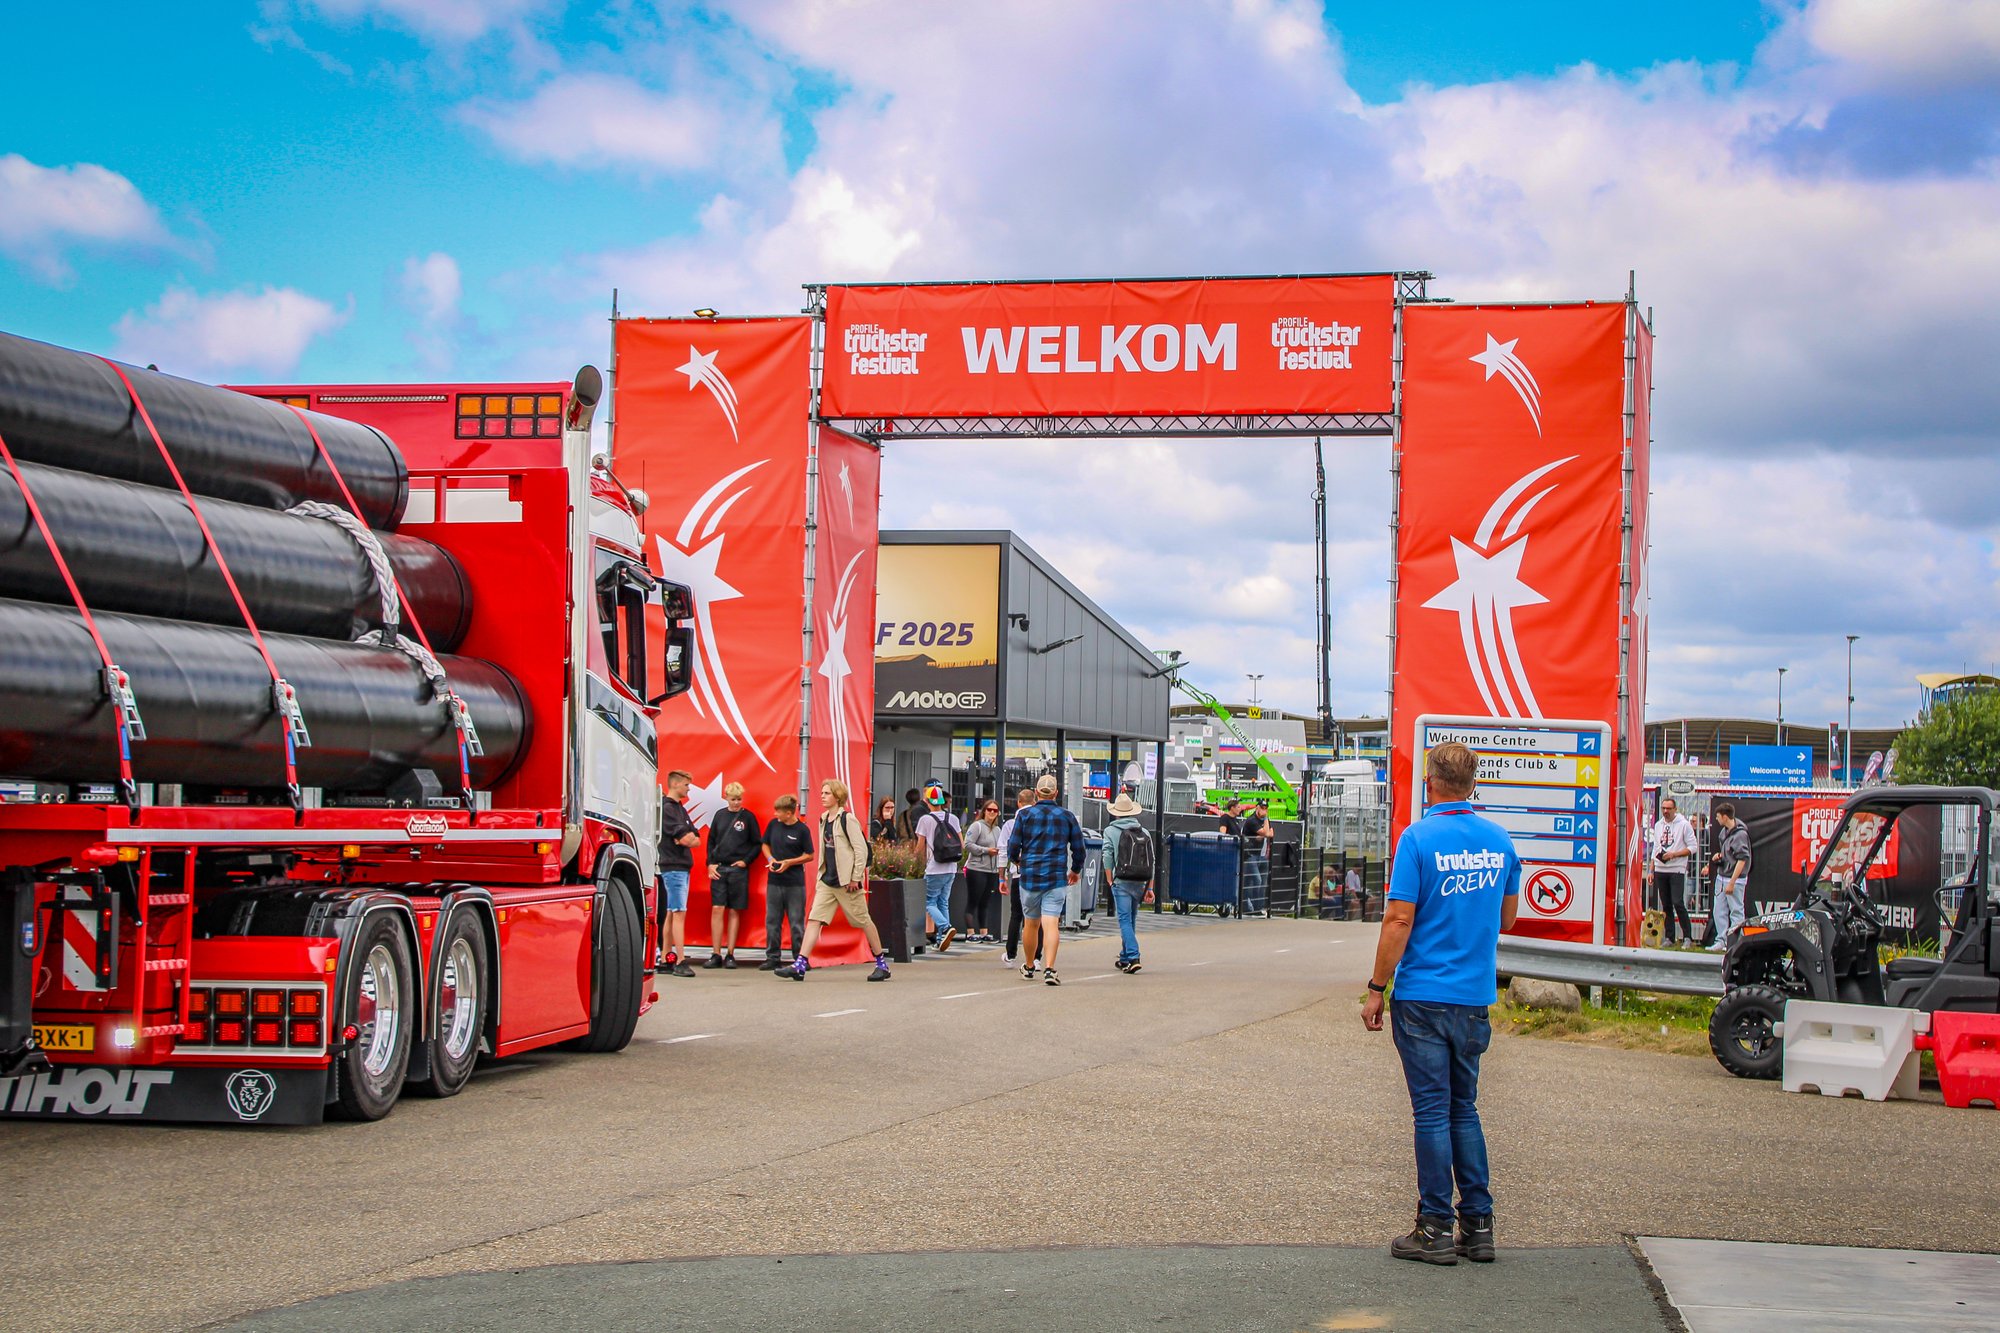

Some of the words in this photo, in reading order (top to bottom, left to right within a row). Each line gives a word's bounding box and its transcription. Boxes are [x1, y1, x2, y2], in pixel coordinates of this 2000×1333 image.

[850, 324, 879, 333] PROFILE
[1278, 317, 1308, 327] PROFILE
[844, 328, 928, 352] truckstar
[1271, 321, 1361, 347] truckstar
[960, 323, 1237, 374] WELKOM
[850, 352, 919, 375] festival
[1279, 346, 1353, 370] festival
[898, 621, 975, 647] 2025
[885, 690, 987, 709] MotoGP
[1250, 708, 1260, 717] W
[1429, 732, 1488, 745] Welcome
[1493, 735, 1536, 747] Centre
[1514, 758, 1543, 770] Club
[1548, 759, 1558, 771] &
[1750, 767, 1781, 775] Welcome
[1782, 768, 1806, 776] Centre
[1809, 808, 1843, 820] PROFILE
[411, 824, 445, 833] NOOTEBOOM
[1556, 820, 1569, 831] P1
[1435, 849, 1505, 871] truckstar
[1441, 869, 1500, 897] CREW
[1760, 912, 1794, 924] PFEIFER
